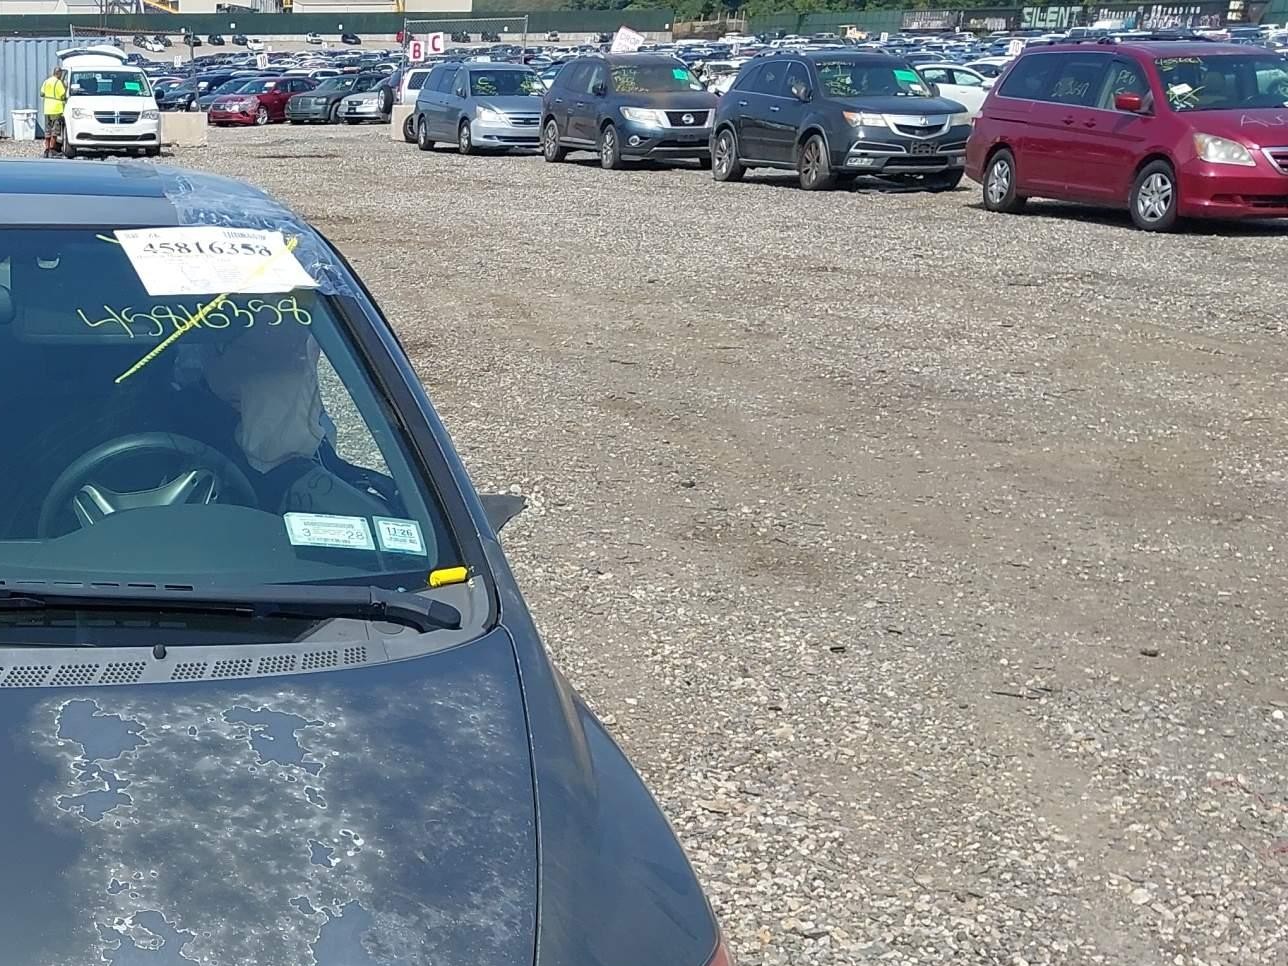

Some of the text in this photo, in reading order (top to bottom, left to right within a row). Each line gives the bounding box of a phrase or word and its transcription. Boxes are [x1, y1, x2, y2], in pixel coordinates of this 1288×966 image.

[1020, 6, 1083, 28] SILENT
[1162, 6, 1201, 15] TRADING
[412, 42, 422, 59] B
[431, 34, 441, 52] C
[142, 240, 273, 257] 45816358
[77, 296, 313, 339] 45816358
